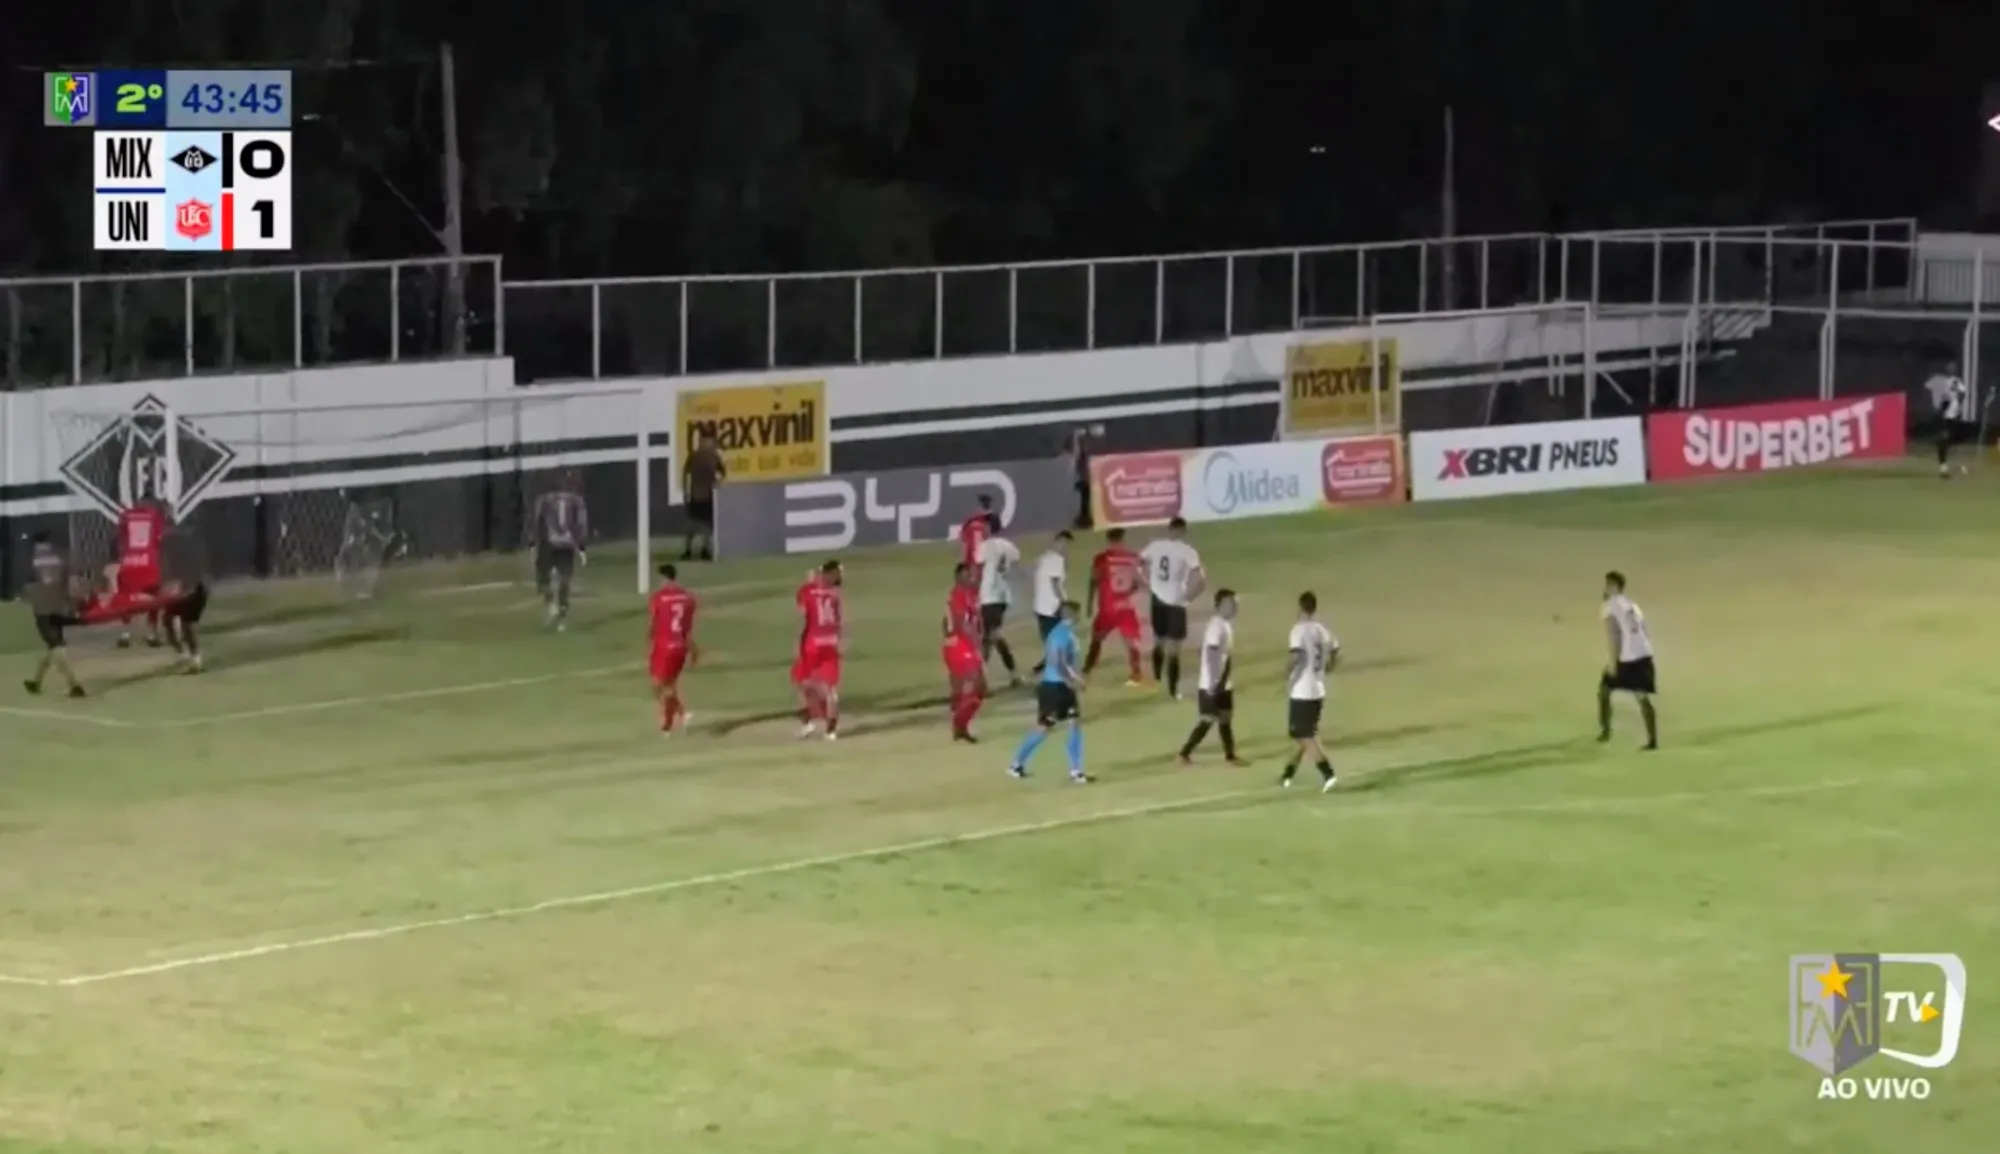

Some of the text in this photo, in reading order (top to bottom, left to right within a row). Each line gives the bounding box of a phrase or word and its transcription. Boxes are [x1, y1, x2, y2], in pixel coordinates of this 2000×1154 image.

[1437, 438, 1620, 481] XBRI PNEUS
[1683, 398, 1876, 471] SUPERBET
[785, 469, 1017, 553] BYD
[1206, 460, 1300, 508] Midea
